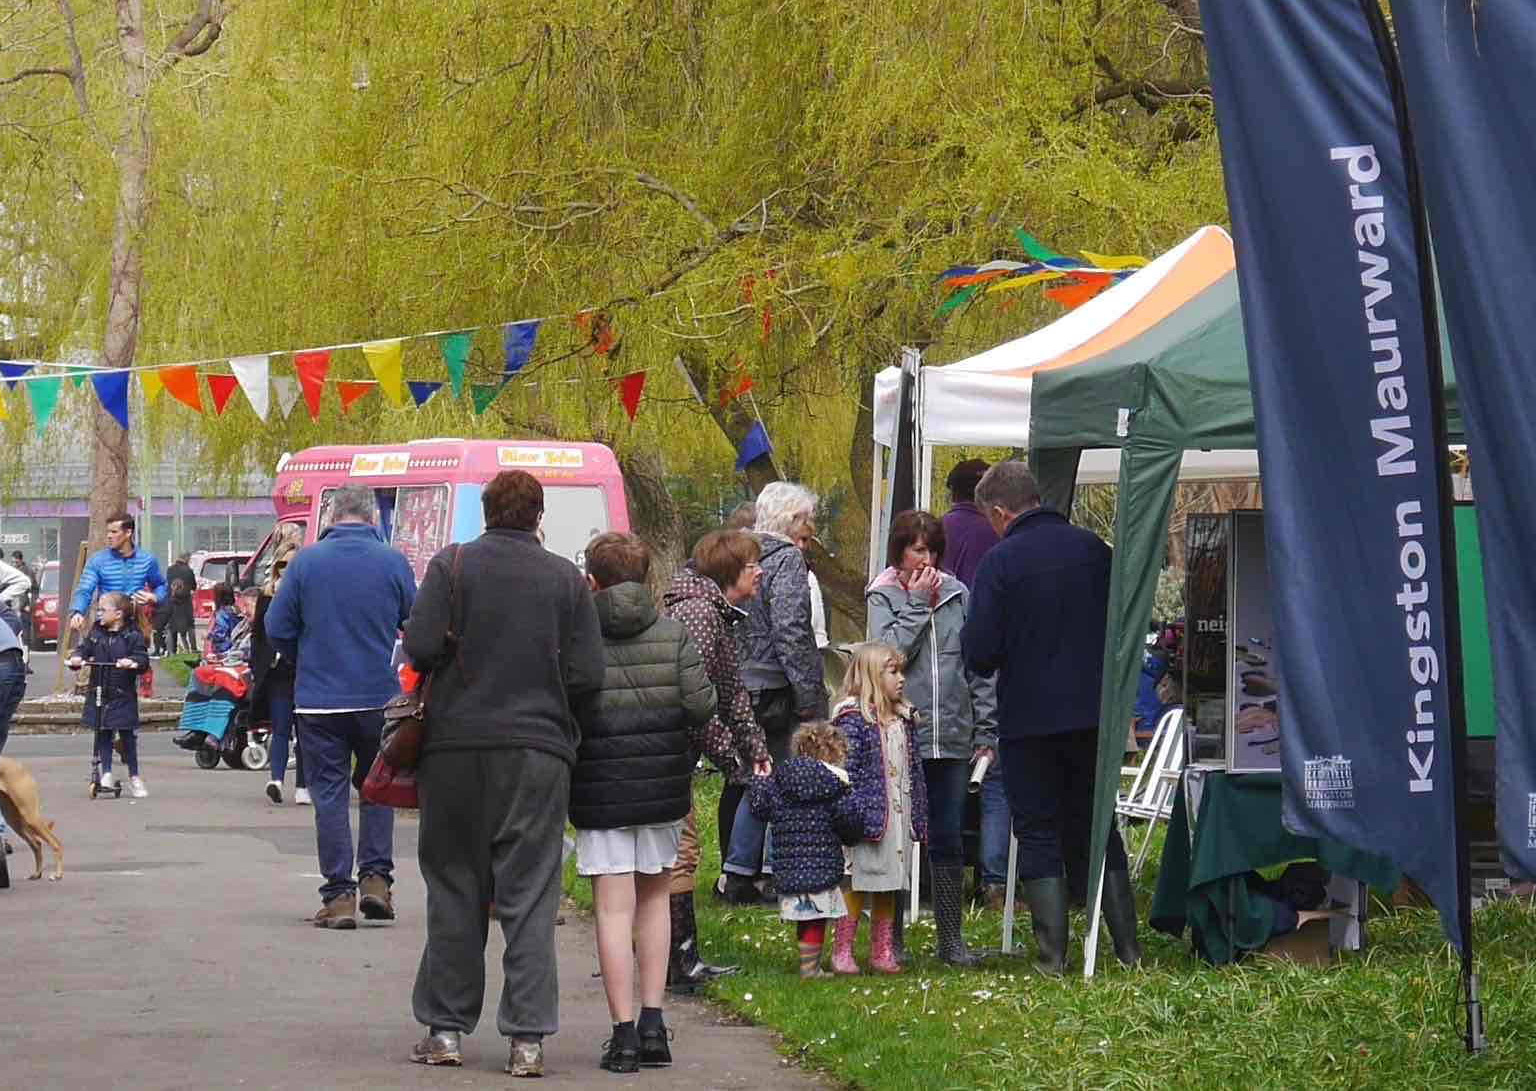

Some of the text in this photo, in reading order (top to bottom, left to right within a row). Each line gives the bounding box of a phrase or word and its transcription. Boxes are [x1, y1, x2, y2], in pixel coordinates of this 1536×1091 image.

[1197, 615, 1229, 632] nei
[1330, 145, 1439, 792] Kingston Maurward
